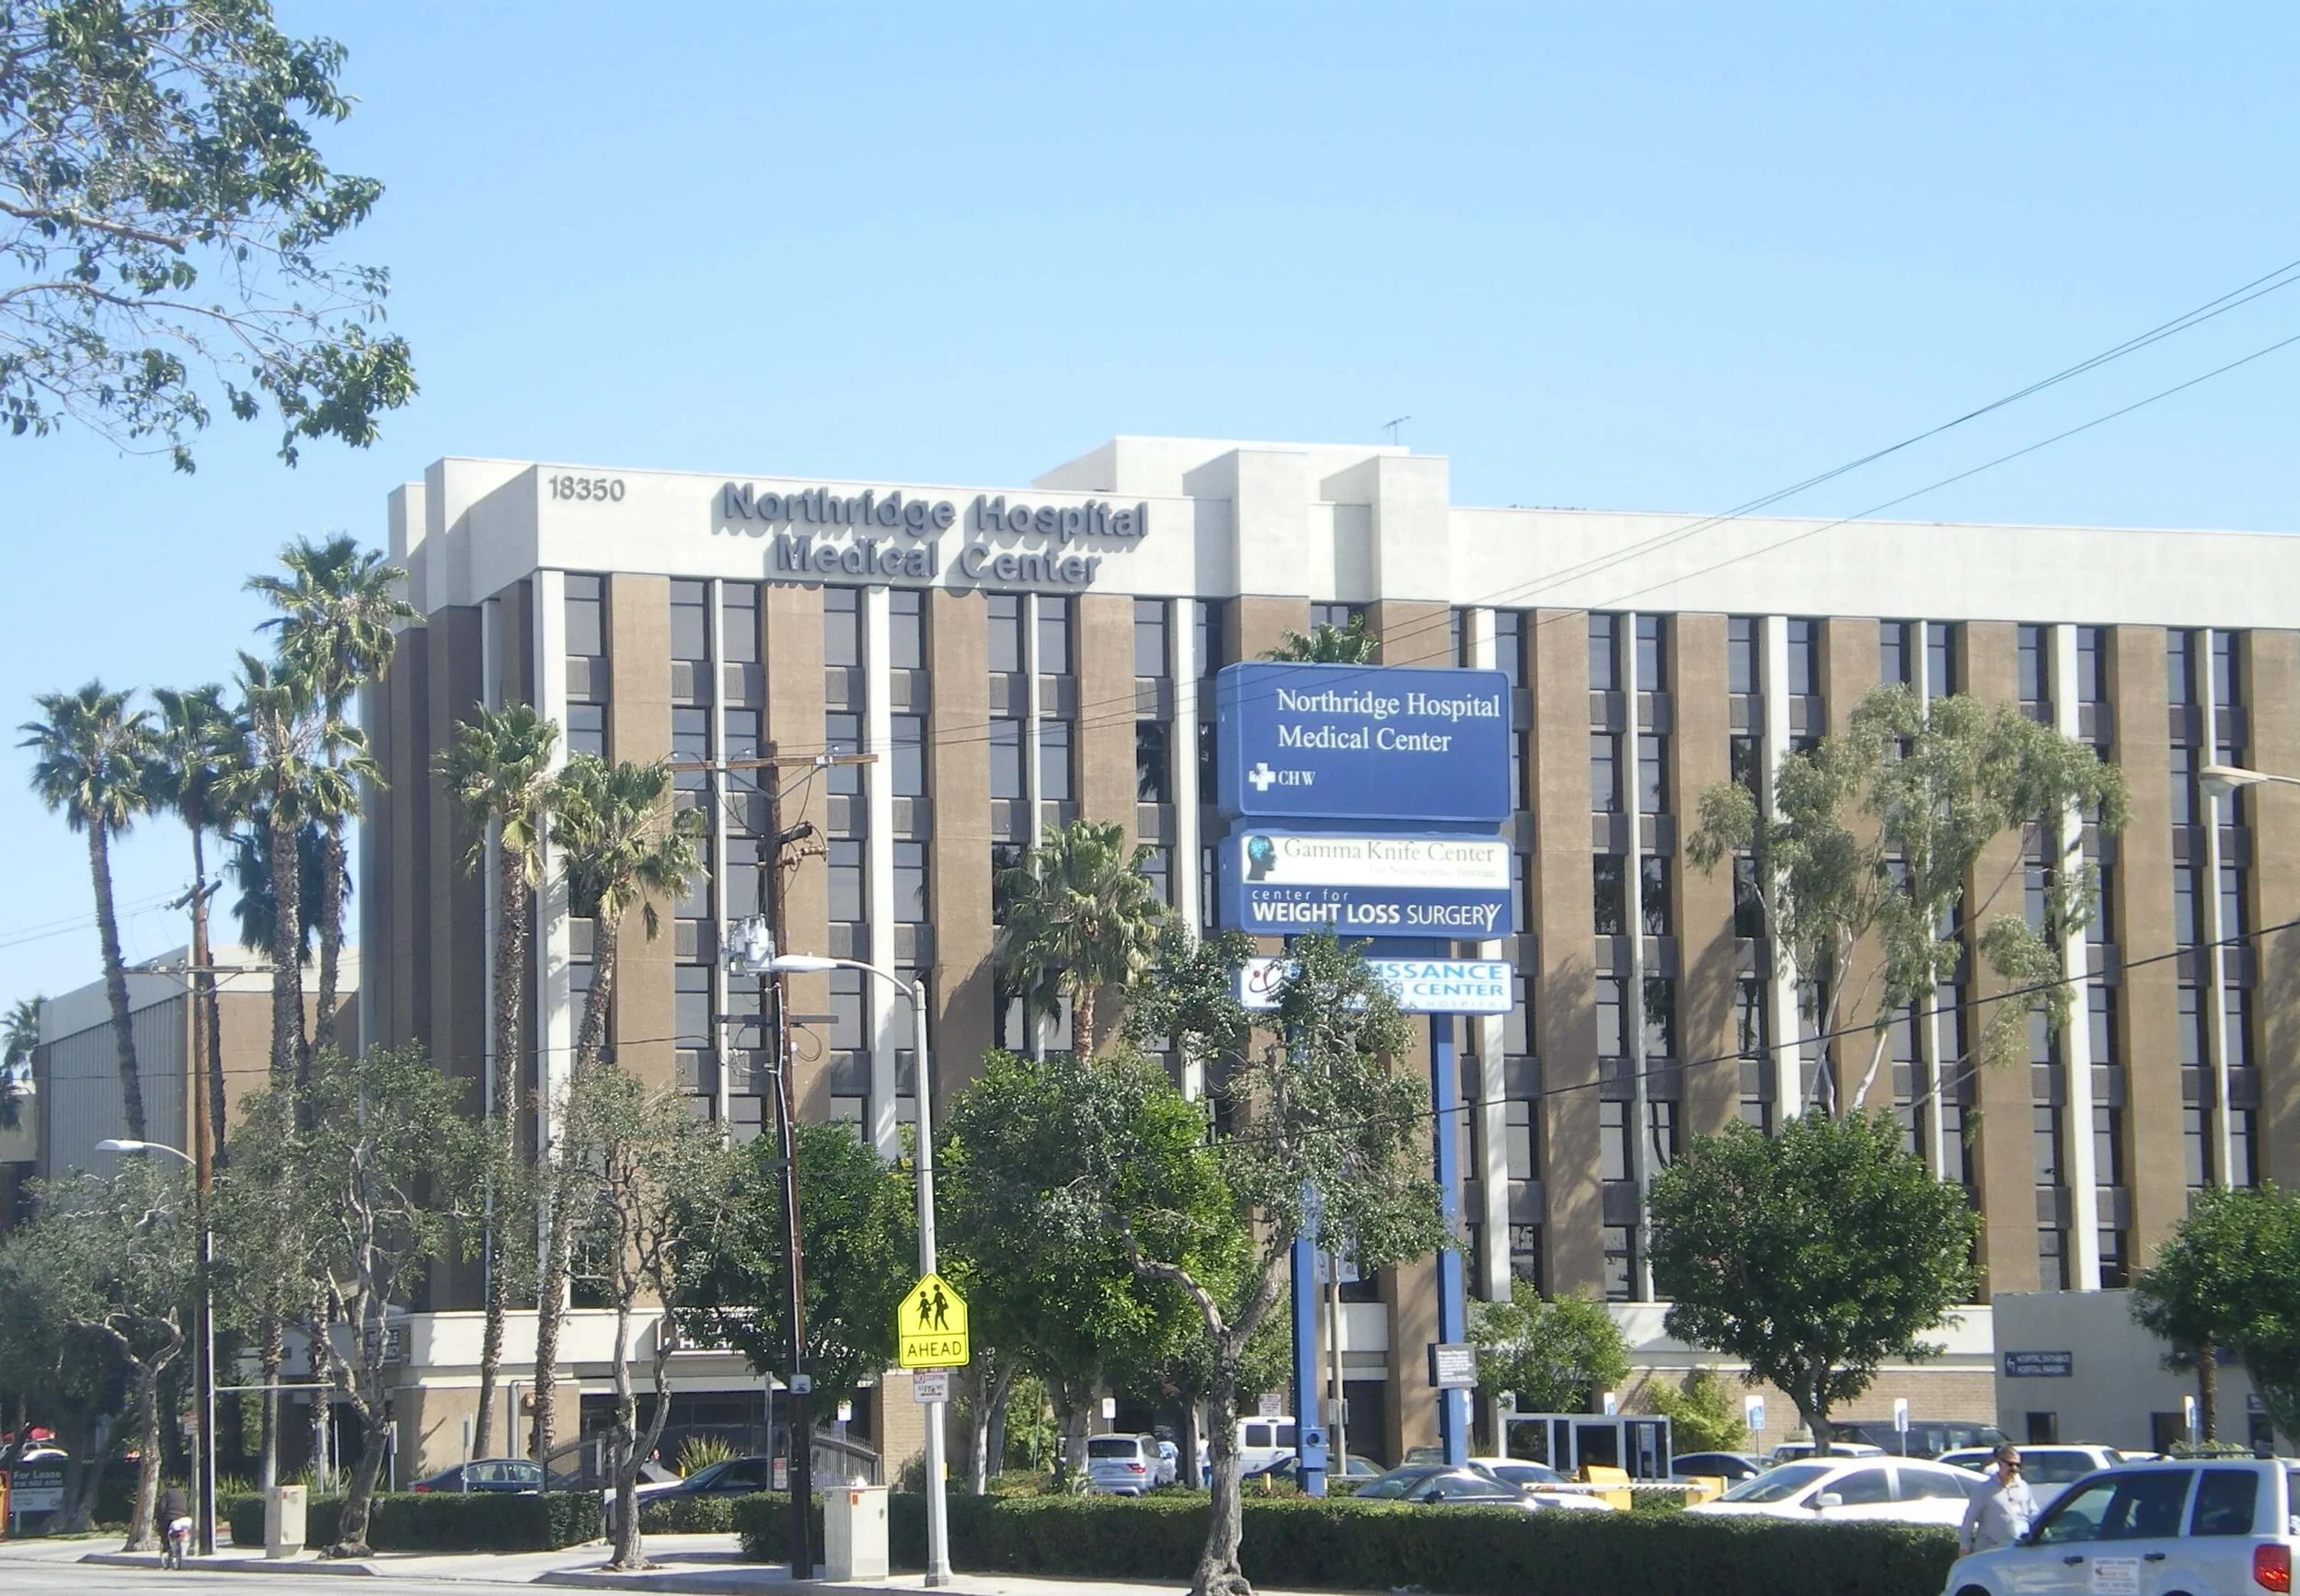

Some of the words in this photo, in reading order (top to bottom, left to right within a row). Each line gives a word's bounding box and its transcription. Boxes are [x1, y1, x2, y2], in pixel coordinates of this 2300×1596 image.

[548, 475, 626, 502] 18350
[723, 481, 956, 537] Northridge
[976, 494, 1148, 543] Hospital
[776, 534, 939, 577] Medical
[960, 542, 1102, 584] Center
[1275, 688, 1400, 719] Northridge
[1407, 692, 1501, 722] Hospital
[1277, 724, 1369, 750] Medical
[1376, 727, 1452, 752] Center
[1278, 770, 1317, 786] CHW
[1284, 837, 1362, 859] Gamma
[1366, 841, 1421, 861] Knife
[1427, 842, 1495, 862] Center
[1251, 890, 1311, 901] center
[1323, 888, 1350, 901] for
[1252, 901, 1341, 923] WEIGHT
[1347, 903, 1401, 924] LOSS
[1407, 903, 1503, 932] SURGERY
[1412, 982, 1505, 996] CENTER
[907, 1340, 962, 1358] AHEAD
[13, 1471, 29, 1480] For
[33, 1470, 63, 1479] Lease
